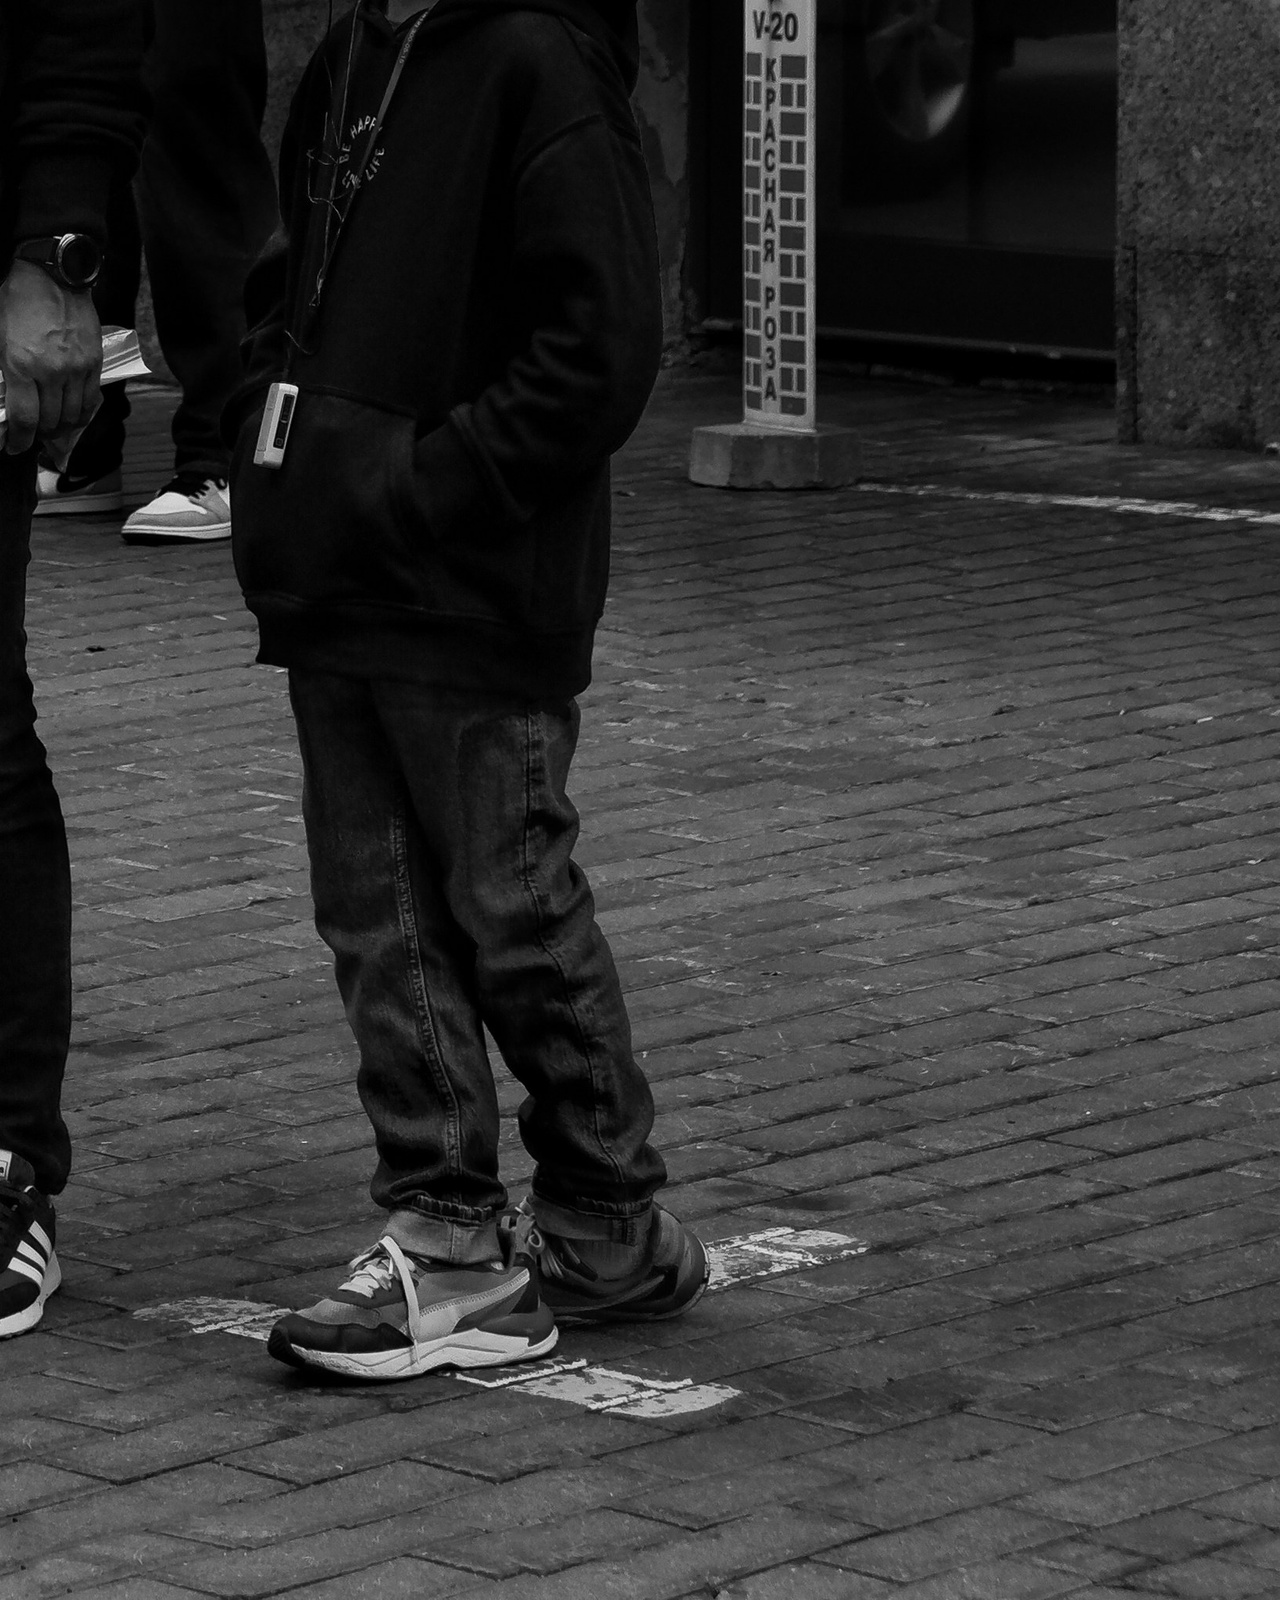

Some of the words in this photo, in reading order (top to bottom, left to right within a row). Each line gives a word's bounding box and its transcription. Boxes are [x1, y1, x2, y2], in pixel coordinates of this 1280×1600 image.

[752, 10, 799, 42] V-20
[338, 142, 352, 164] BE
[349, 114, 384, 140] HAPP
[763, 57, 777, 263] КРАСНАЯ
[365, 147, 386, 182] LIFE
[763, 286, 777, 402] РОЗА
